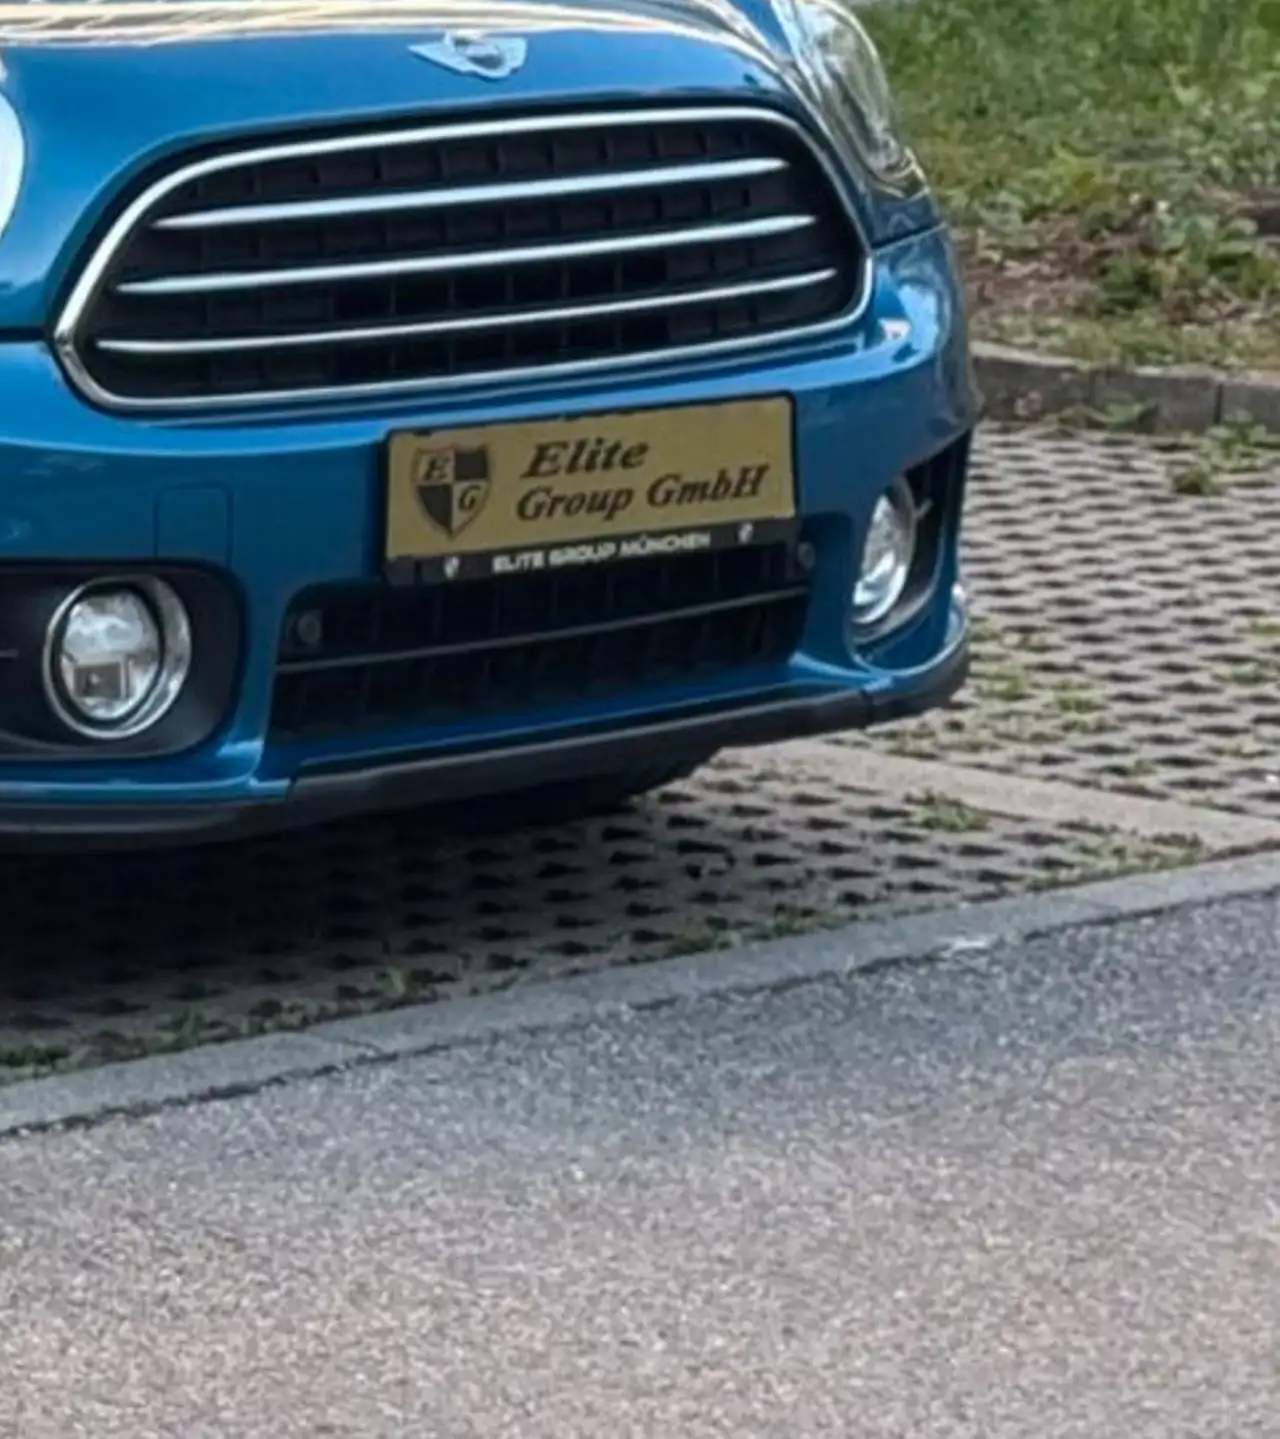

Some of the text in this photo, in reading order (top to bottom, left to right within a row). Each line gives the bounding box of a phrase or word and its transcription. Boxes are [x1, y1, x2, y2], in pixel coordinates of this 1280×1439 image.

[520, 437, 650, 479] Elite
[517, 462, 770, 522] Group GmbH
[493, 550, 544, 573] ELITE
[549, 541, 616, 566] GROUP
